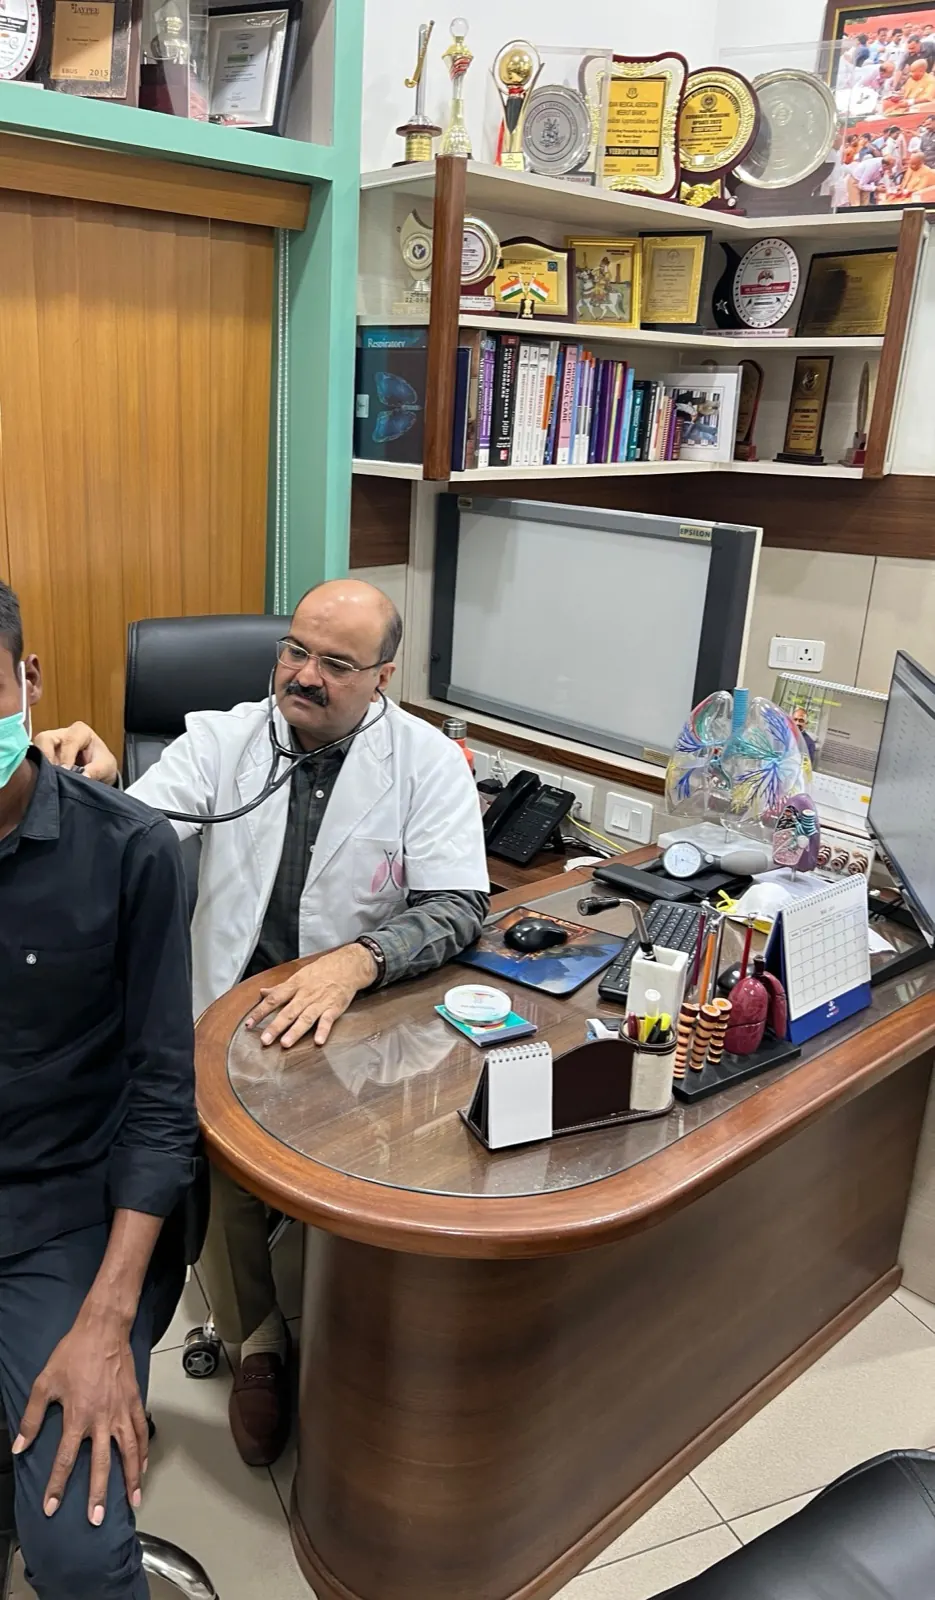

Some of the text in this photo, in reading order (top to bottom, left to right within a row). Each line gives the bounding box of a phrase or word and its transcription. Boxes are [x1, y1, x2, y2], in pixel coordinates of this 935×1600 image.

[89, 69, 109, 77] 2015
[367, 337, 406, 348] Respiratory
[564, 362, 573, 402] CRITICAL
[680, 528, 710, 537] EPSILON
